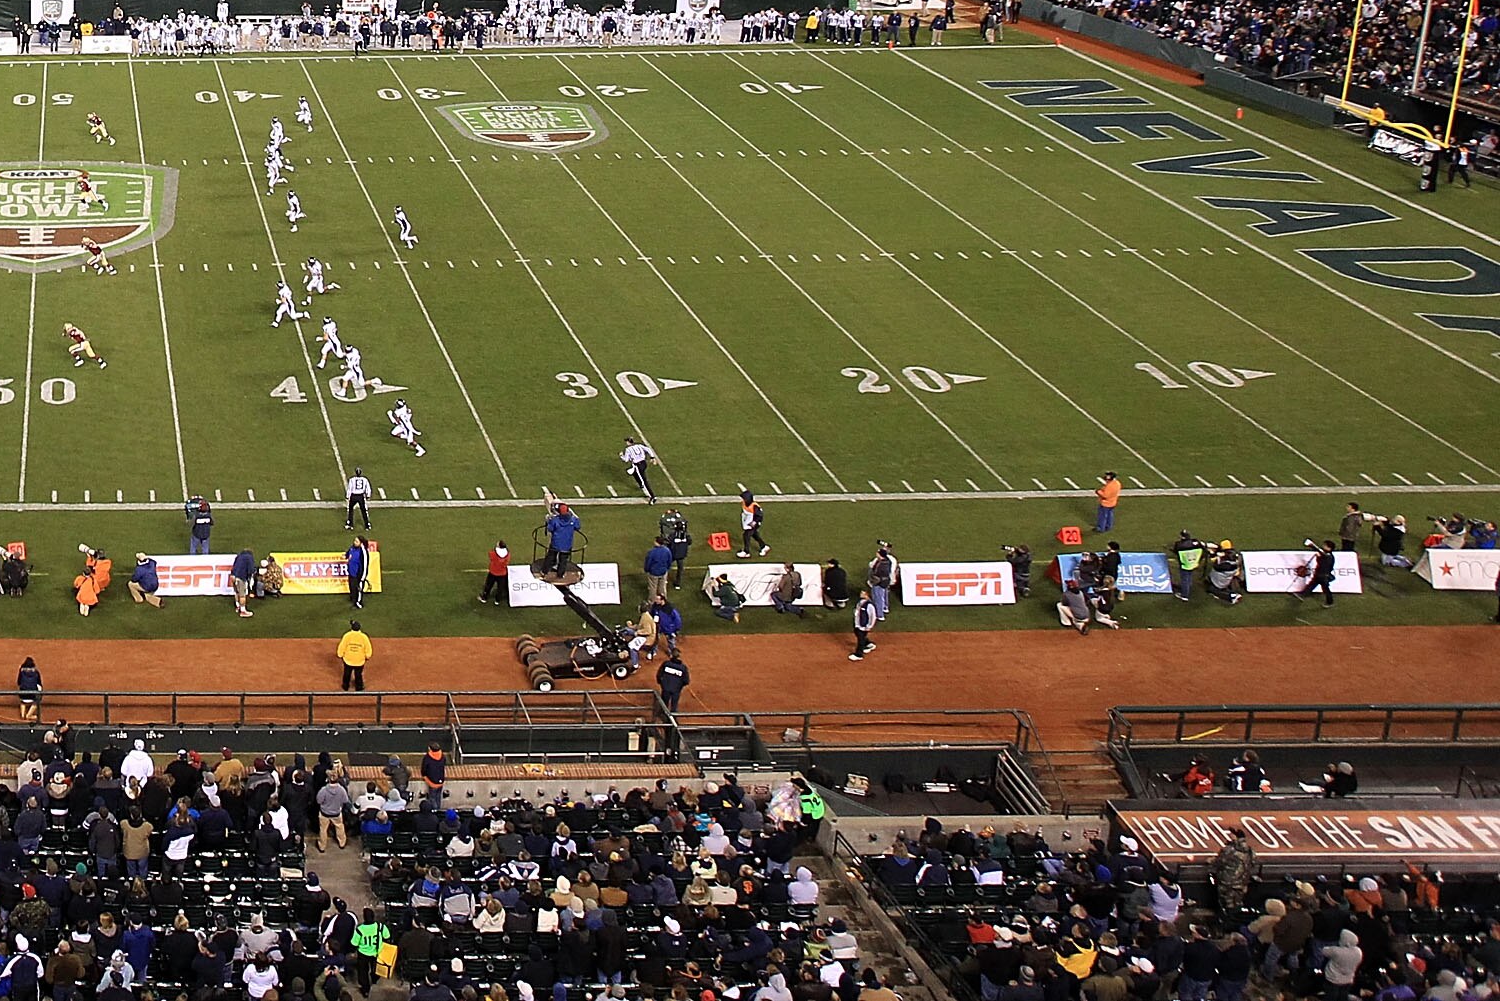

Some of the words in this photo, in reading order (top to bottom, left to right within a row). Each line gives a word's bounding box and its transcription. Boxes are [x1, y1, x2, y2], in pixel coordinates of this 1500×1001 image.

[10, 170, 73, 178] KRAFT
[714, 535, 728, 548] 30
[1064, 530, 1078, 543] 20
[1117, 564, 1153, 576] PLIED
[915, 572, 1001, 597] ESPN
[1116, 575, 1154, 587] ERIALS
[1240, 816, 1294, 849] OF
[1288, 815, 1379, 849] THE
[1366, 815, 1474, 849] SAN
